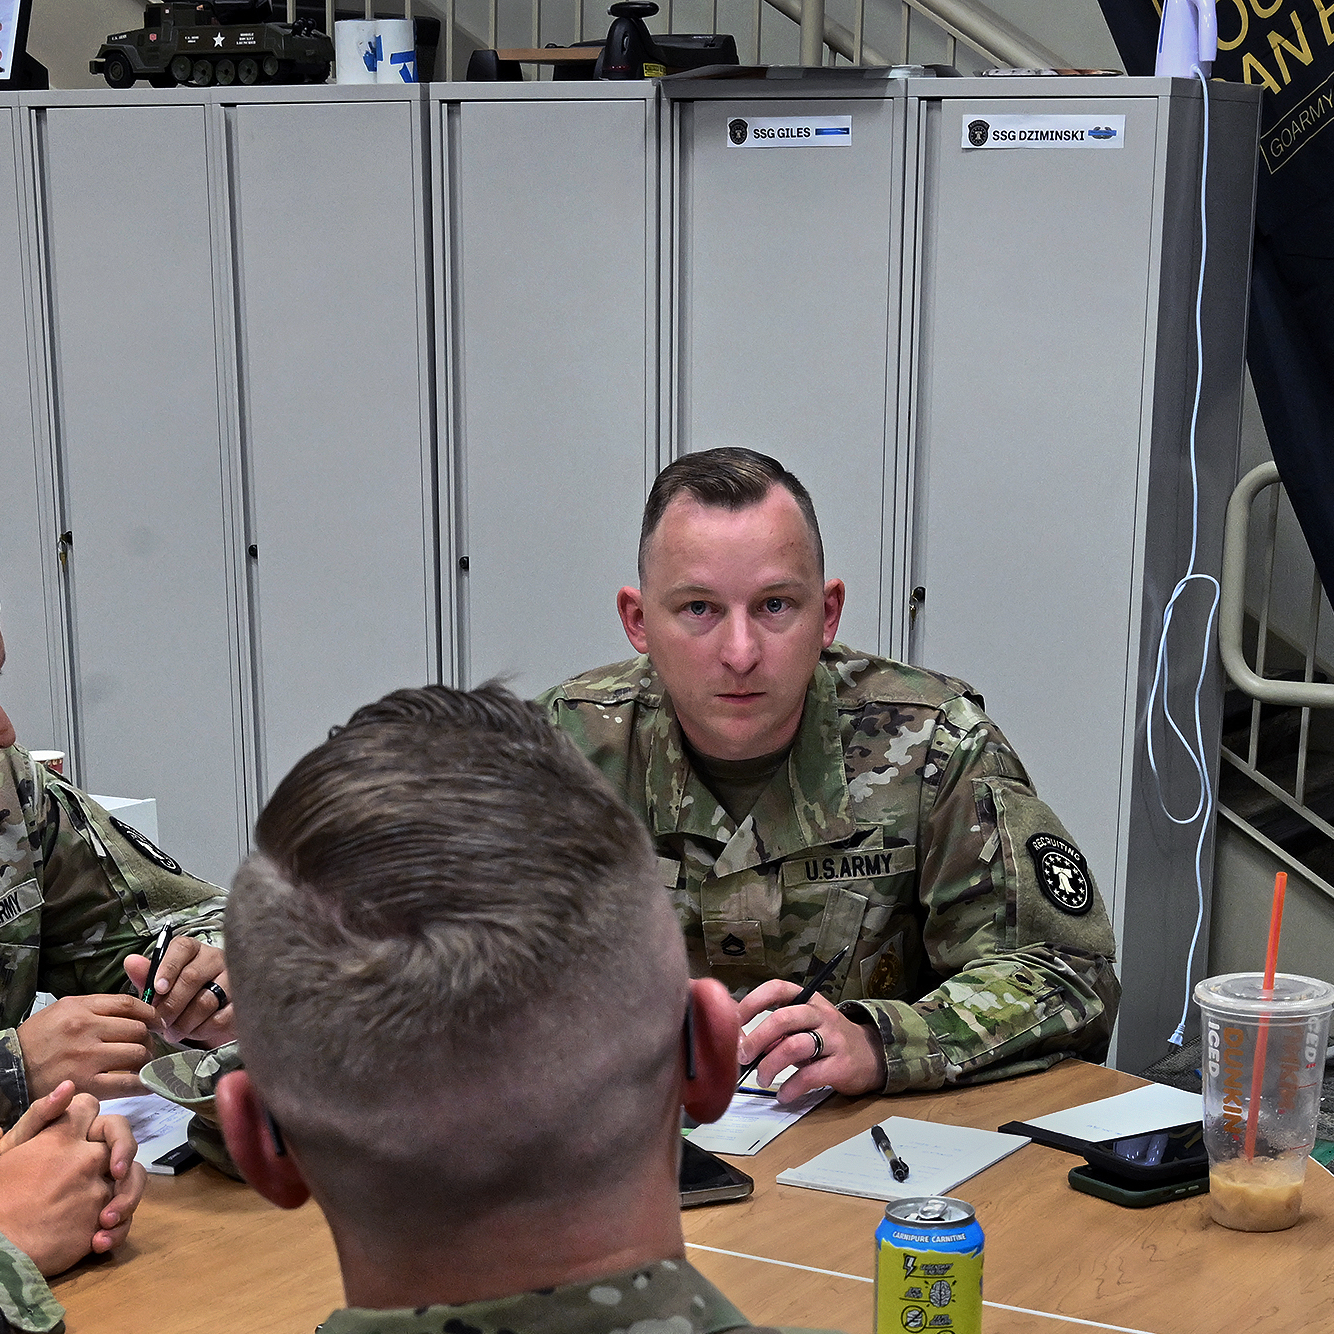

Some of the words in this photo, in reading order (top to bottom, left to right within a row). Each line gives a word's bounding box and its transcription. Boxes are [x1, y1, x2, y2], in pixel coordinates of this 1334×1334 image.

[1241, 11, 1314, 95] AN
[753, 128, 775, 139] SSG
[777, 127, 811, 139] GILES
[992, 130, 1017, 141] SSG
[1018, 130, 1085, 141] DZIMINSKI
[1032, 836, 1081, 861] RECRUITING
[1208, 1020, 1220, 1078] ICED
[893, 1231, 929, 1242] CARNIPURE
[932, 1232, 966, 1243] CARNITINE
